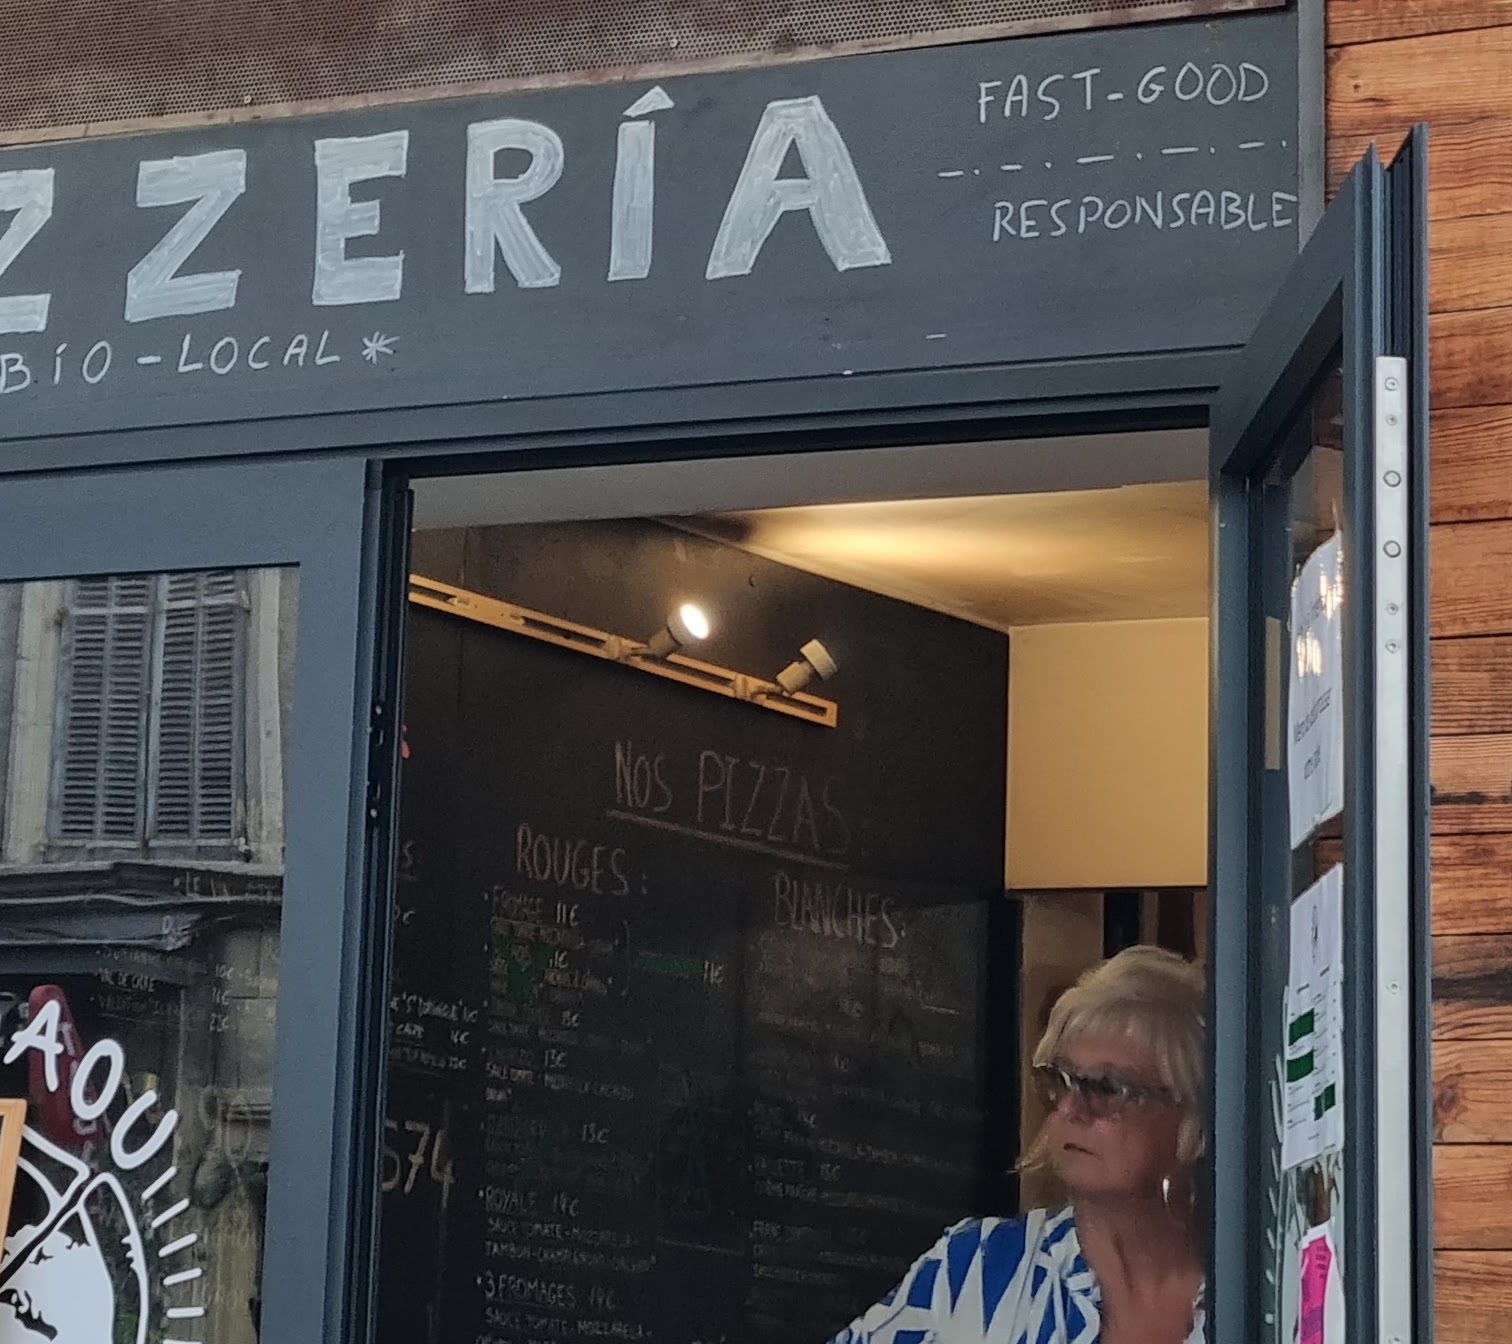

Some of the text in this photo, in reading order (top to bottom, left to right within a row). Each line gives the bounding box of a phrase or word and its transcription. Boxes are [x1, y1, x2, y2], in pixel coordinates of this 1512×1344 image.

[991, 190, 1298, 242] RESPONSABLE
[615, 740, 851, 855] NOS PIZZAS
